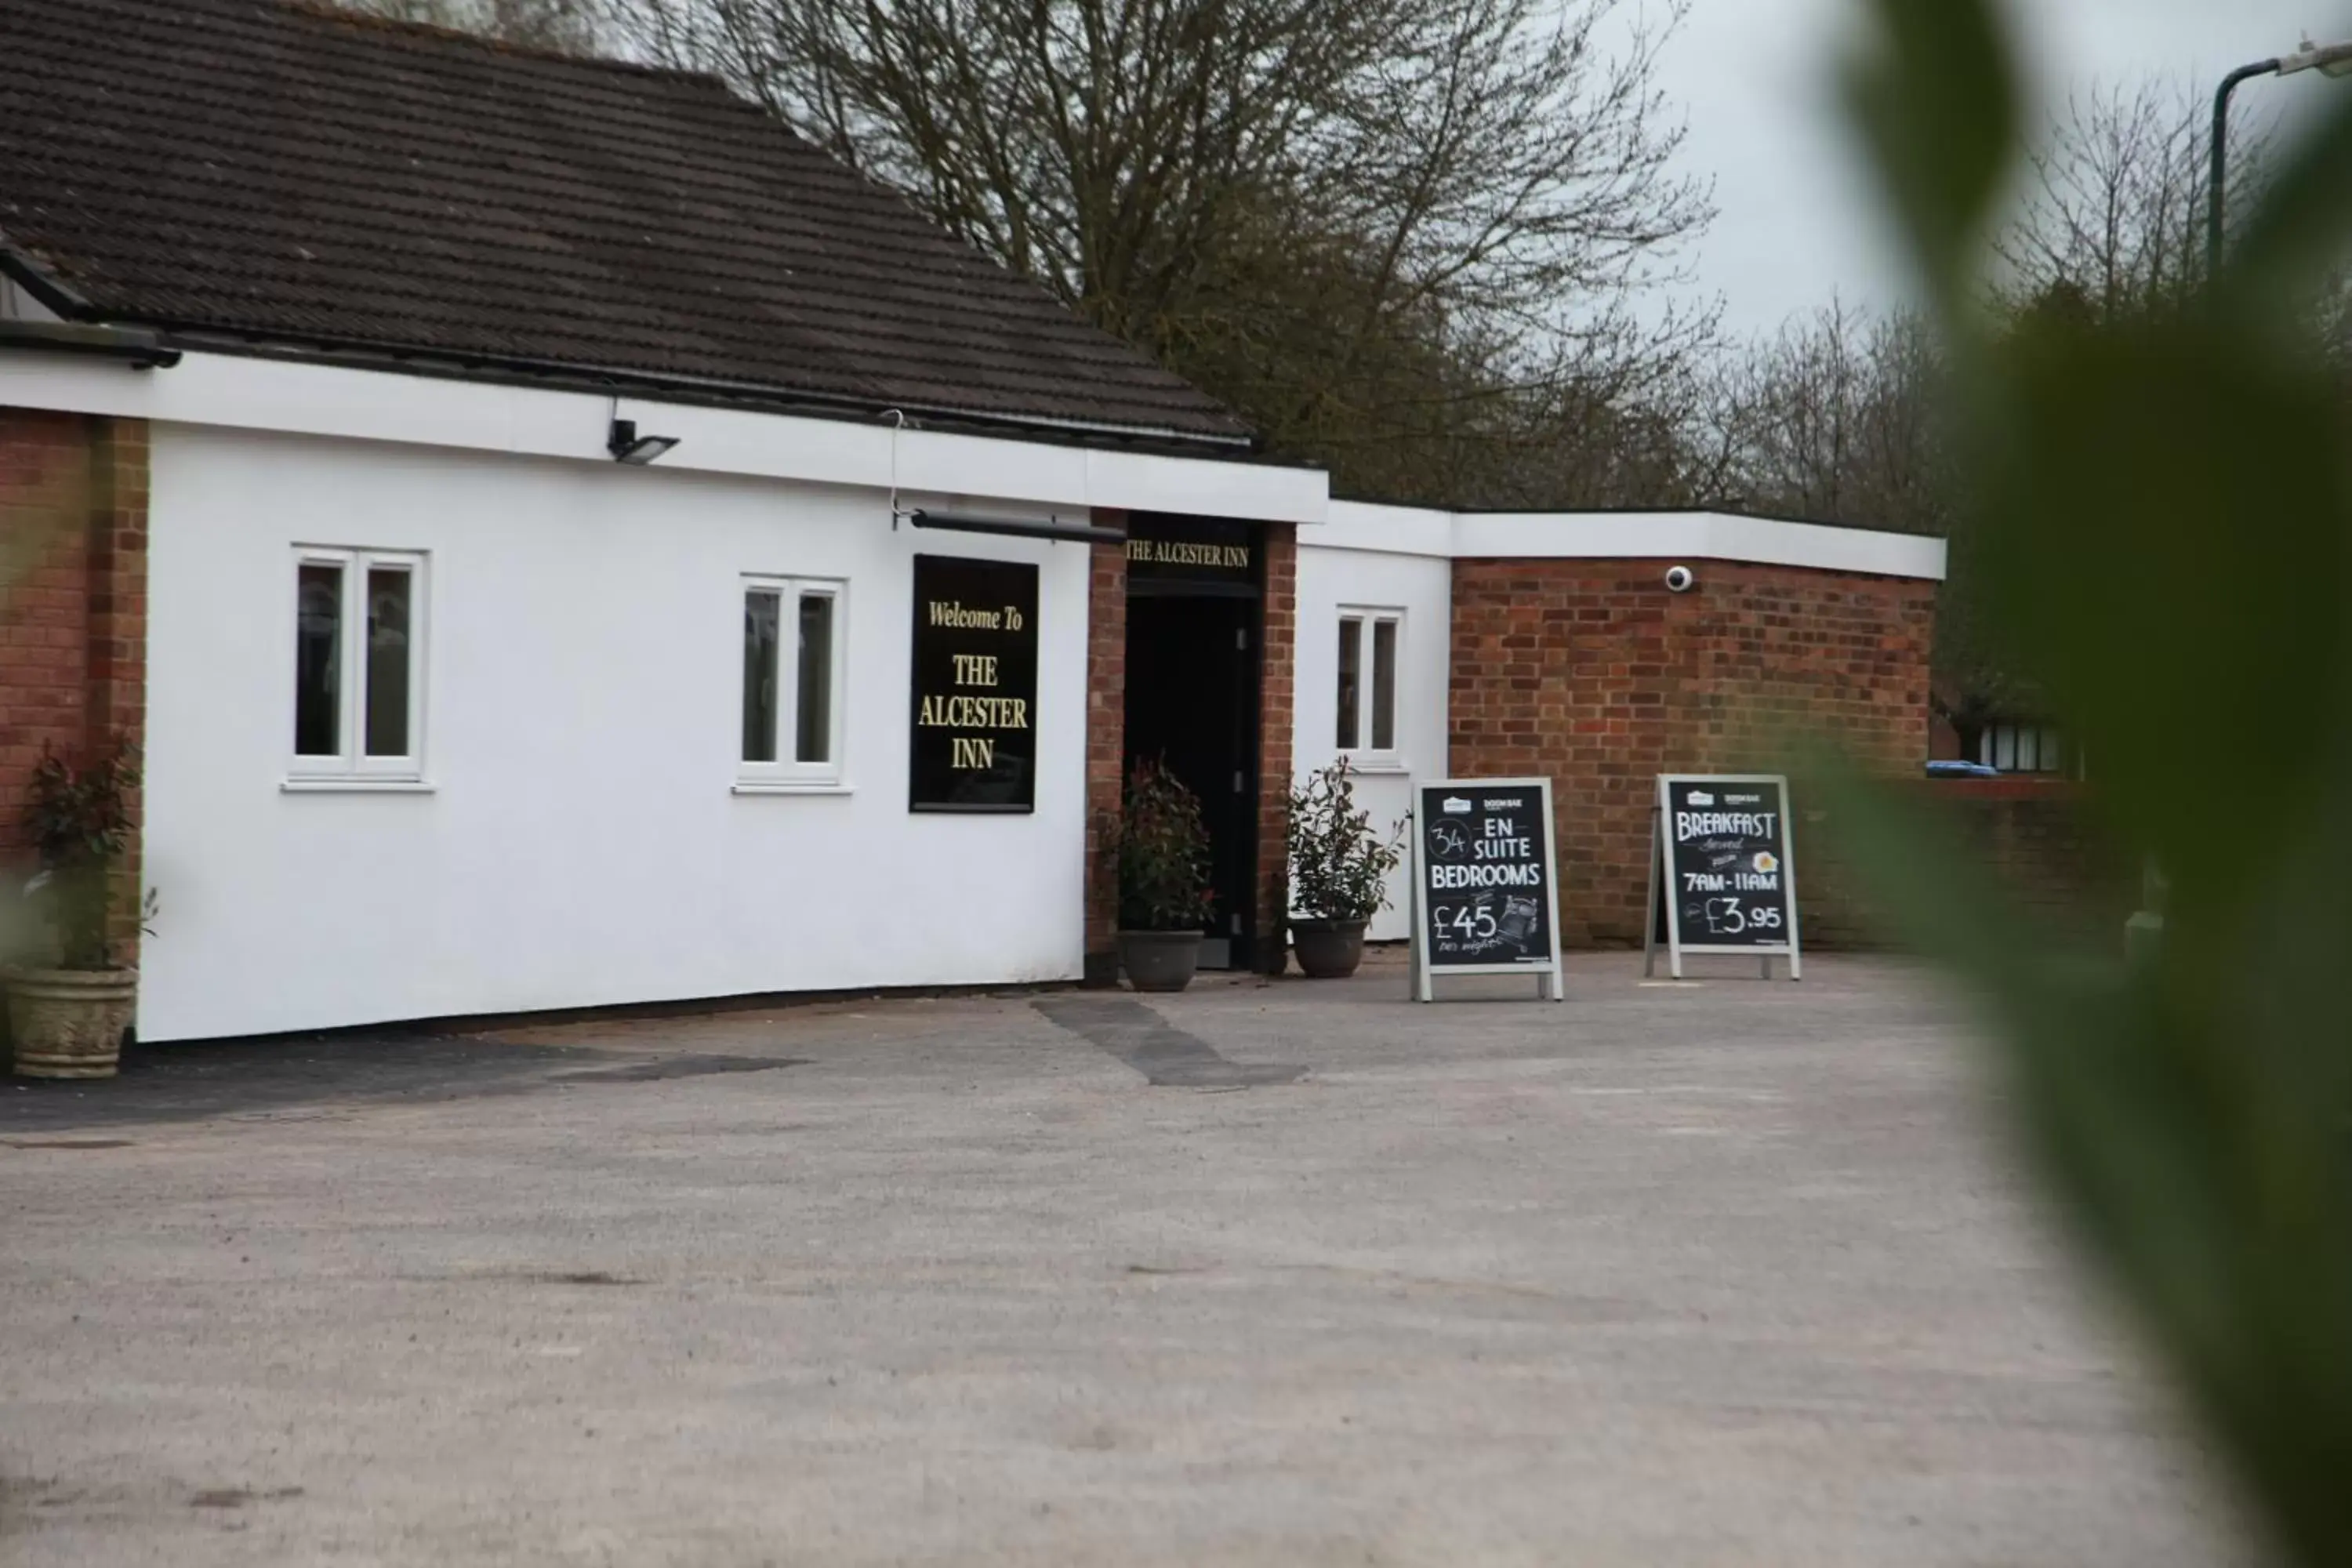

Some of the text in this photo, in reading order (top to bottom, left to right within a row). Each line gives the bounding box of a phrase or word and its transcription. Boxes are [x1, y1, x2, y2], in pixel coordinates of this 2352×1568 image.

[1154, 542, 1221, 565] ALCESTER
[1224, 546, 1250, 568] INN
[929, 601, 1022, 631] Welcome To
[953, 654, 998, 687] THE
[918, 695, 1029, 728] ALCESTER
[951, 738, 994, 769] INN
[1432, 827, 1466, 855] 34
[1484, 818, 1513, 837] EN
[1676, 811, 1776, 841] BREAKFAST
[1474, 837, 1531, 860] SUITE
[1432, 863, 1541, 888] BEDROOMS
[1434, 905, 1497, 938] £45
[1705, 897, 1782, 934] £3.95
